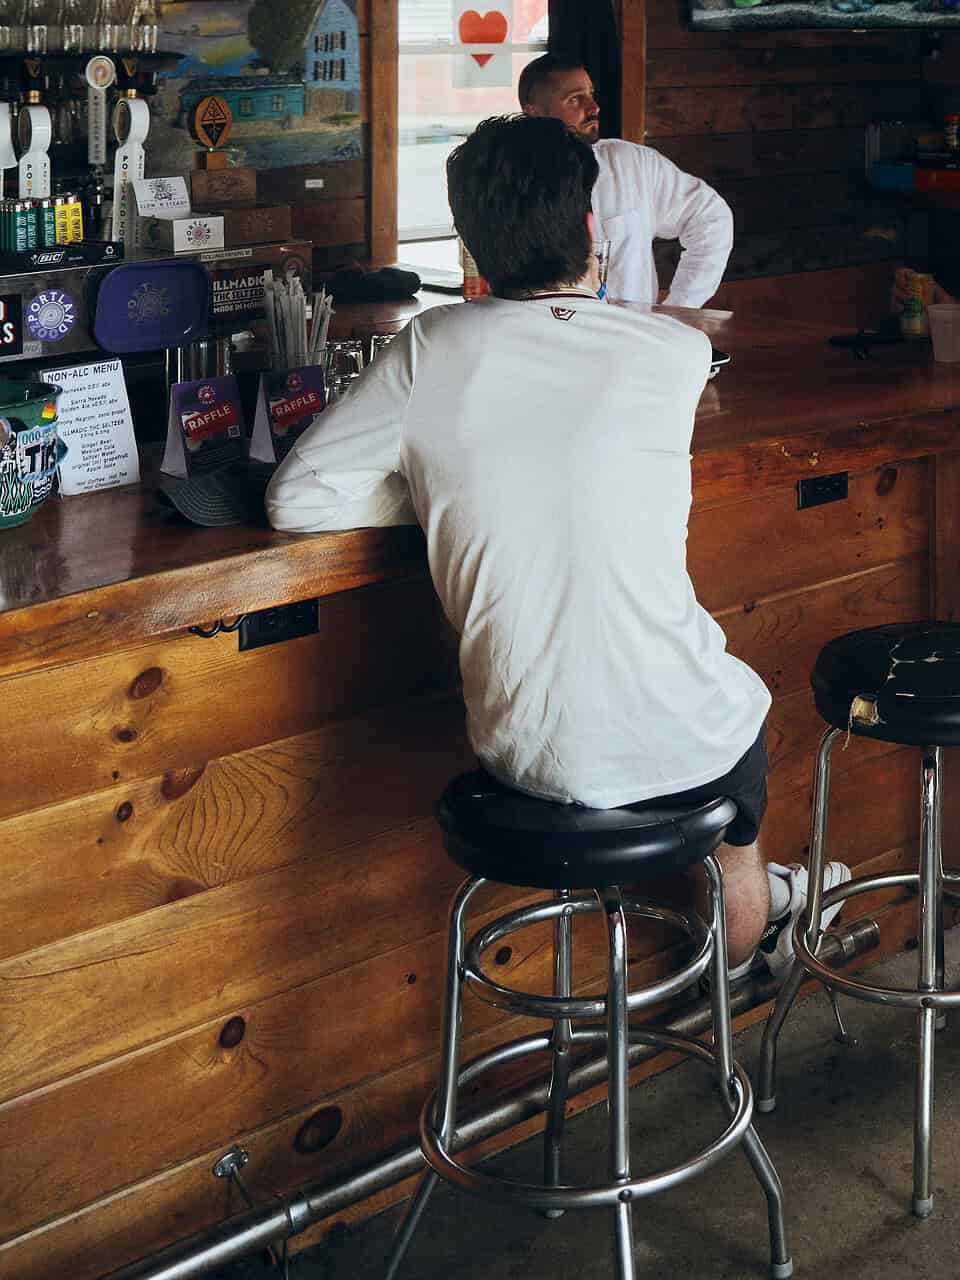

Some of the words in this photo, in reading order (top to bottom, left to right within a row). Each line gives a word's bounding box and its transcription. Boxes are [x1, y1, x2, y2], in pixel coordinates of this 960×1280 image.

[40, 252, 62, 264] BIC
[213, 276, 265, 291] ILLMADIC
[27, 291, 75, 334] PORTLAND
[47, 367, 90, 383] NON-ALC
[93, 362, 120, 376] MENU
[276, 393, 317, 418] RAFFLE
[187, 405, 232, 432] RAFFLE
